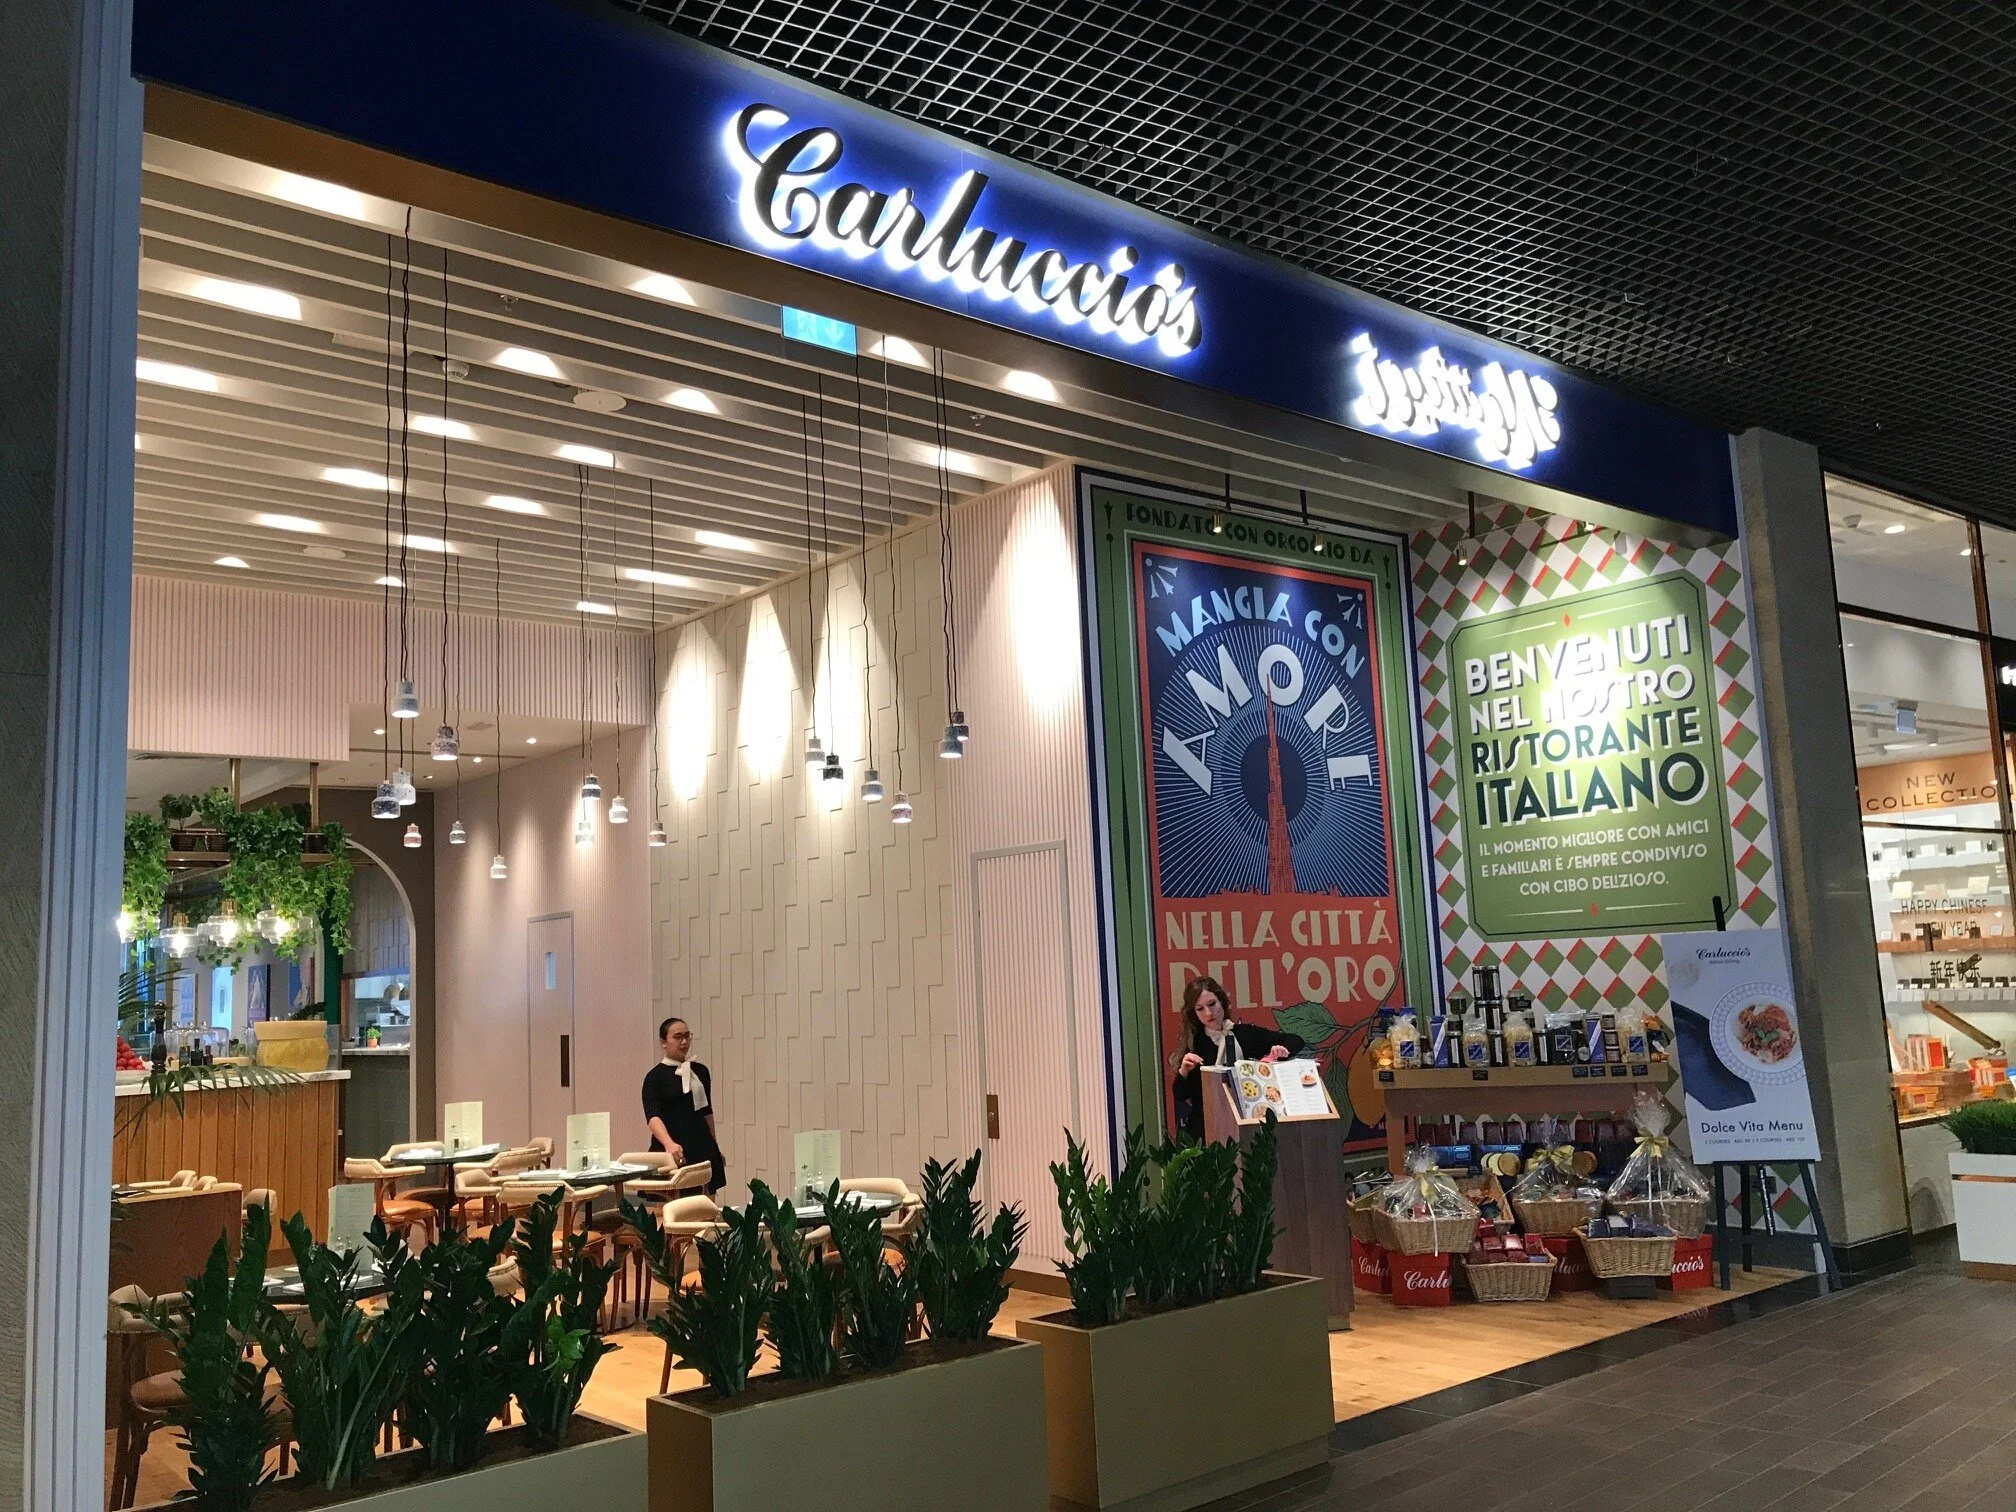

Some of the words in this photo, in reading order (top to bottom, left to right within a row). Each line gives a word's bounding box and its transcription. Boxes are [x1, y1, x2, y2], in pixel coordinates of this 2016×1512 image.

[735, 102, 1202, 355] Carluccio's
[1224, 522, 1258, 545] CON
[1351, 547, 1375, 566] DA
[1155, 586, 1293, 657] MANGIA
[1304, 610, 1365, 679] CON
[1465, 614, 1694, 696] BENVENUTI
[1162, 644, 1373, 796] AMORE
[1470, 694, 1532, 735] NEL
[1544, 664, 1695, 723] NOSTRO
[1472, 705, 1702, 776] RISTORANTE
[1475, 751, 1710, 829] ITALIANO
[1866, 785, 2005, 811] COLLECTIO
[1906, 772, 1956, 789] NEW
[1479, 842, 1490, 857] IL
[1493, 835, 1559, 855] MOMENTO
[1562, 828, 1625, 845] MIGLIORE
[1628, 824, 1662, 841] CON
[1665, 818, 1710, 837] AMICI
[1481, 866, 1490, 878] E
[1492, 858, 1552, 876] FAMILIARI
[1556, 852, 1564, 871] È
[1567, 848, 1618, 870] SEMPRE
[1622, 843, 1708, 866] CONDIVISO
[1519, 880, 1550, 896] CON
[1553, 877, 1589, 893] CIBO
[1593, 870, 1670, 891] DELIZIOSO.
[1165, 910, 1280, 950] NELLA
[1290, 899, 1392, 947] CITTÀ
[1901, 899, 1938, 915] HAPPY
[1941, 899, 1988, 914] CHINESE
[1695, 946, 1751, 960] Carluccio's
[1701, 1121, 1736, 1134] Dolce
[1739, 1120, 1764, 1132] Vita
[1768, 1120, 1804, 1131] Menu
